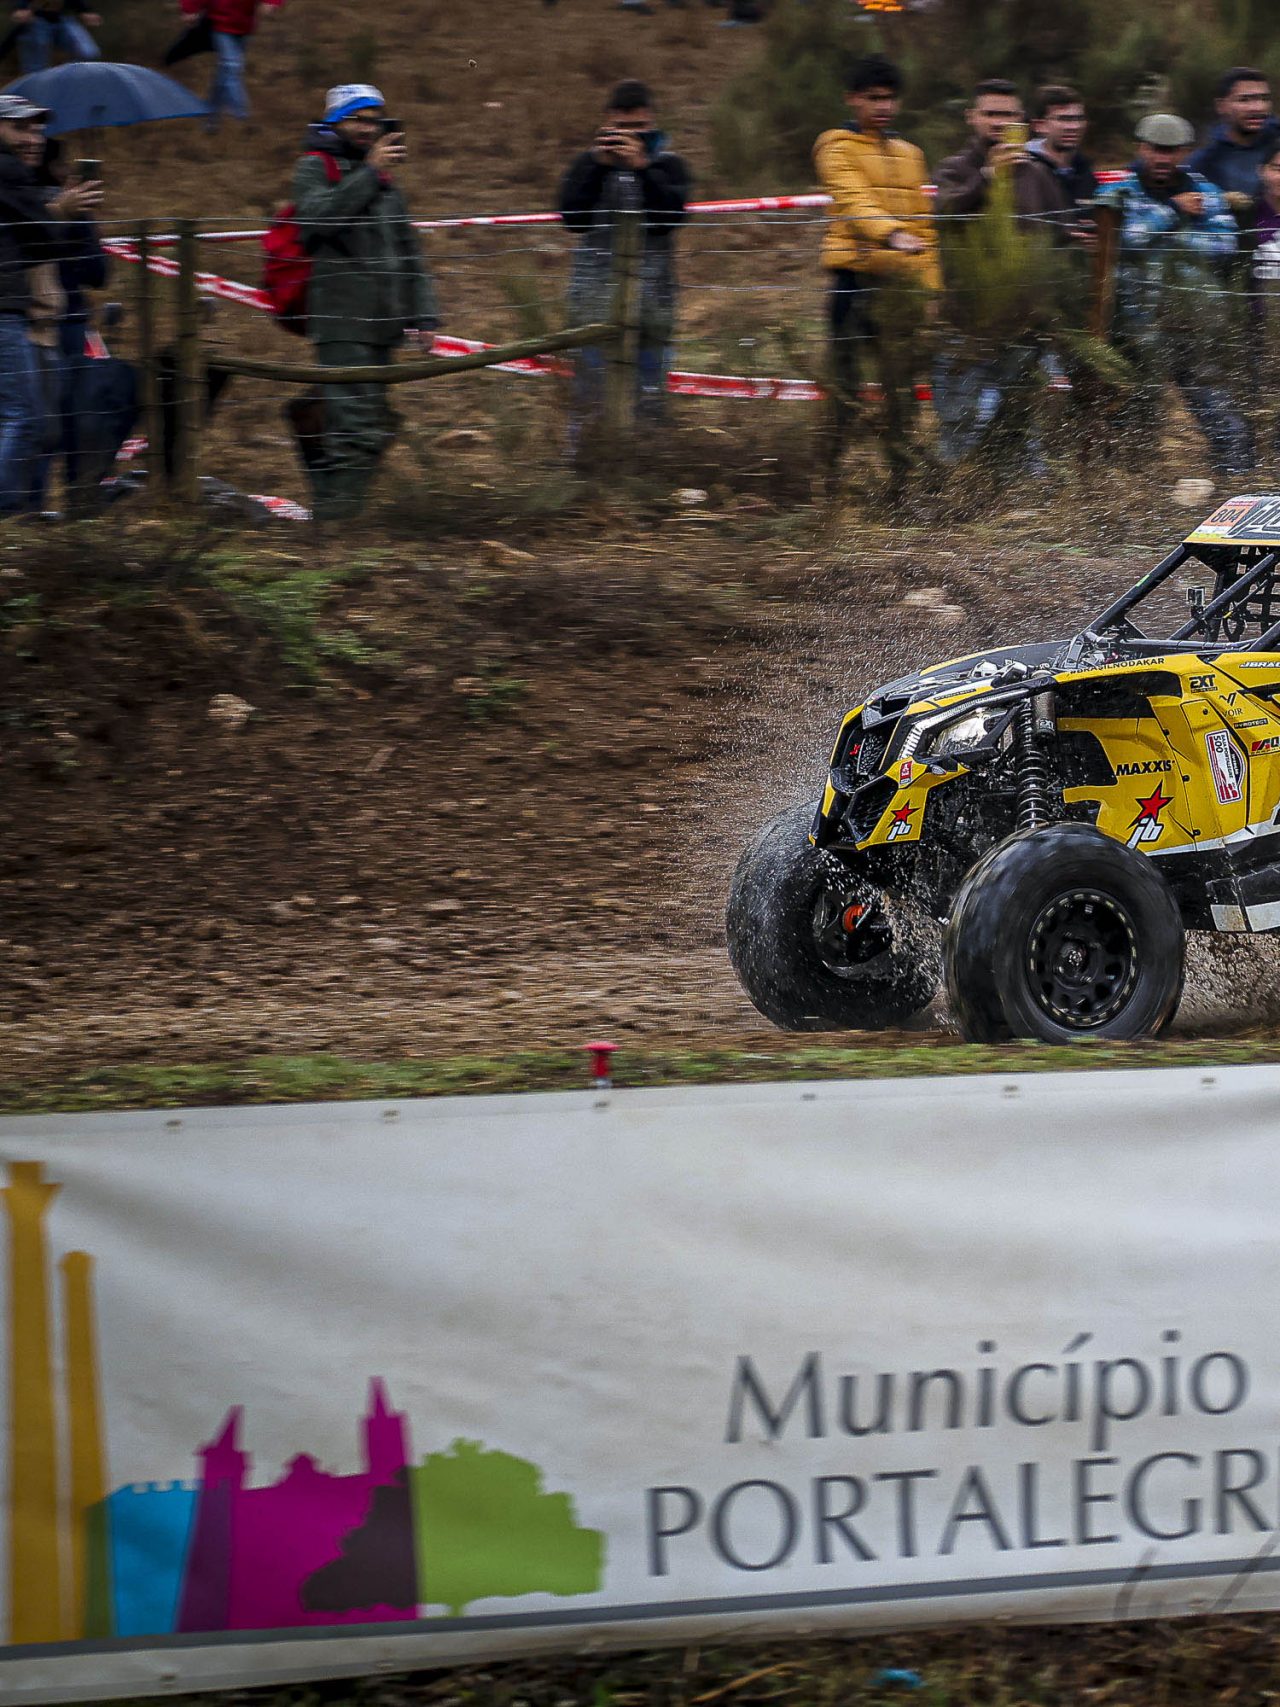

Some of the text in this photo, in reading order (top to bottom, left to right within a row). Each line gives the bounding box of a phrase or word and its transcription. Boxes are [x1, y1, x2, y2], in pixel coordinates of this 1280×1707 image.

[1210, 508, 1245, 523] 804
[1213, 735, 1224, 753] 500
[1116, 760, 1172, 776] MAXXIS
[723, 1329, 1251, 1451] Município
